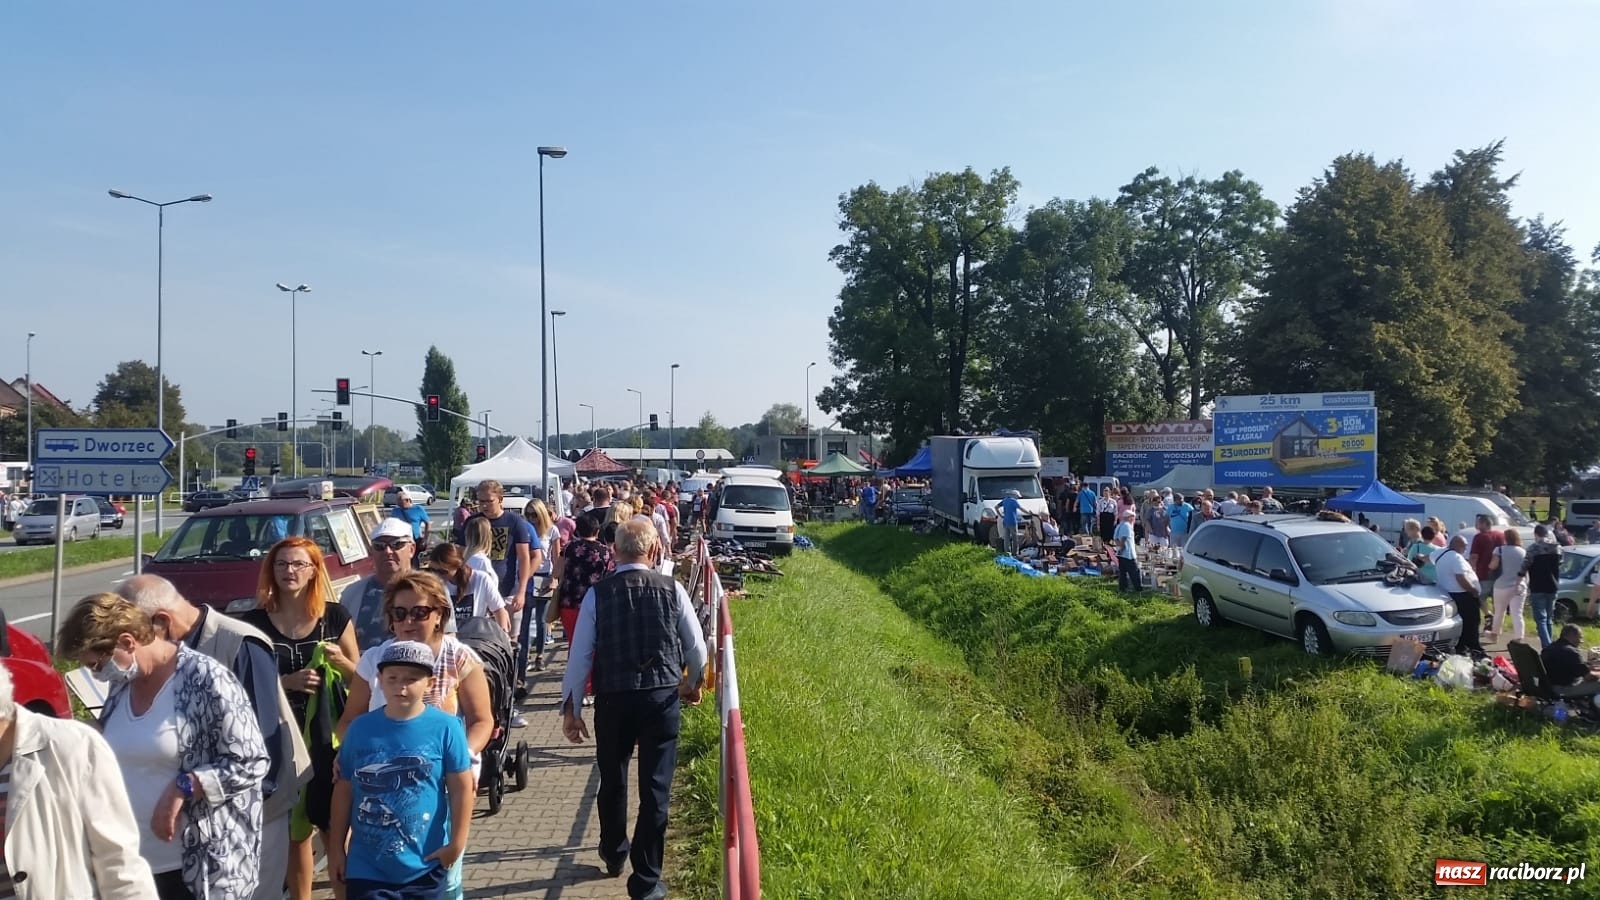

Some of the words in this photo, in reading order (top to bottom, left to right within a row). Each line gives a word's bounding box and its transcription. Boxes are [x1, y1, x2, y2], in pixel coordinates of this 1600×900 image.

[1260, 396, 1275, 405] 25
[1280, 396, 1301, 405] km
[1324, 396, 1369, 404] castorama
[1343, 417, 1362, 425] DOM
[1111, 423, 1207, 433] DYWYTA
[1238, 424, 1269, 433] PRODUKT
[1235, 432, 1263, 441] ZAGRAJ
[85, 438, 155, 452] Dworzec
[1220, 448, 1233, 458] 23
[1233, 447, 1271, 457] URODZINY
[67, 469, 138, 486] Hotel
[1141, 470, 1152, 478] km
